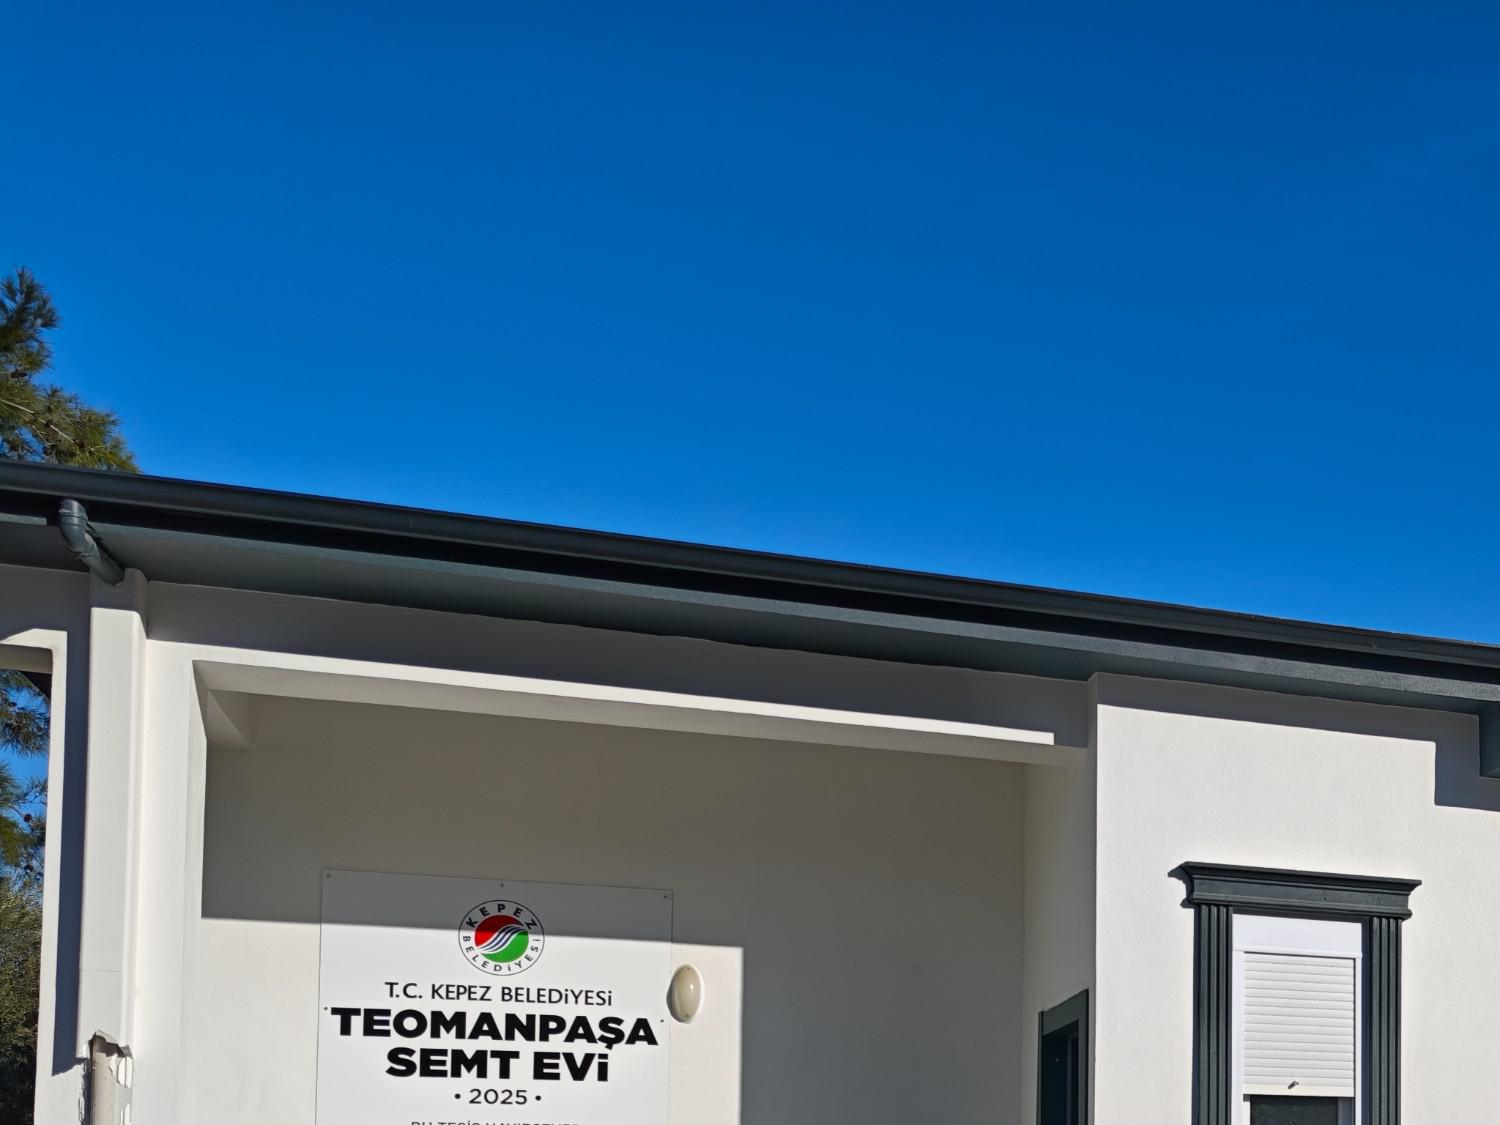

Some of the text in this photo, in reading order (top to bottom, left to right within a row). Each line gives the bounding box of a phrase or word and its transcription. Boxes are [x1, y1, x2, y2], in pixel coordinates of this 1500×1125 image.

[466, 904, 537, 929] KEPEZ
[384, 982, 422, 999] T.C.
[431, 984, 492, 1001] KEPEZ
[331, 1007, 658, 1050] TEOMANPAŞA
[385, 1047, 520, 1079] SEMT
[469, 1089, 527, 1105] 2025
